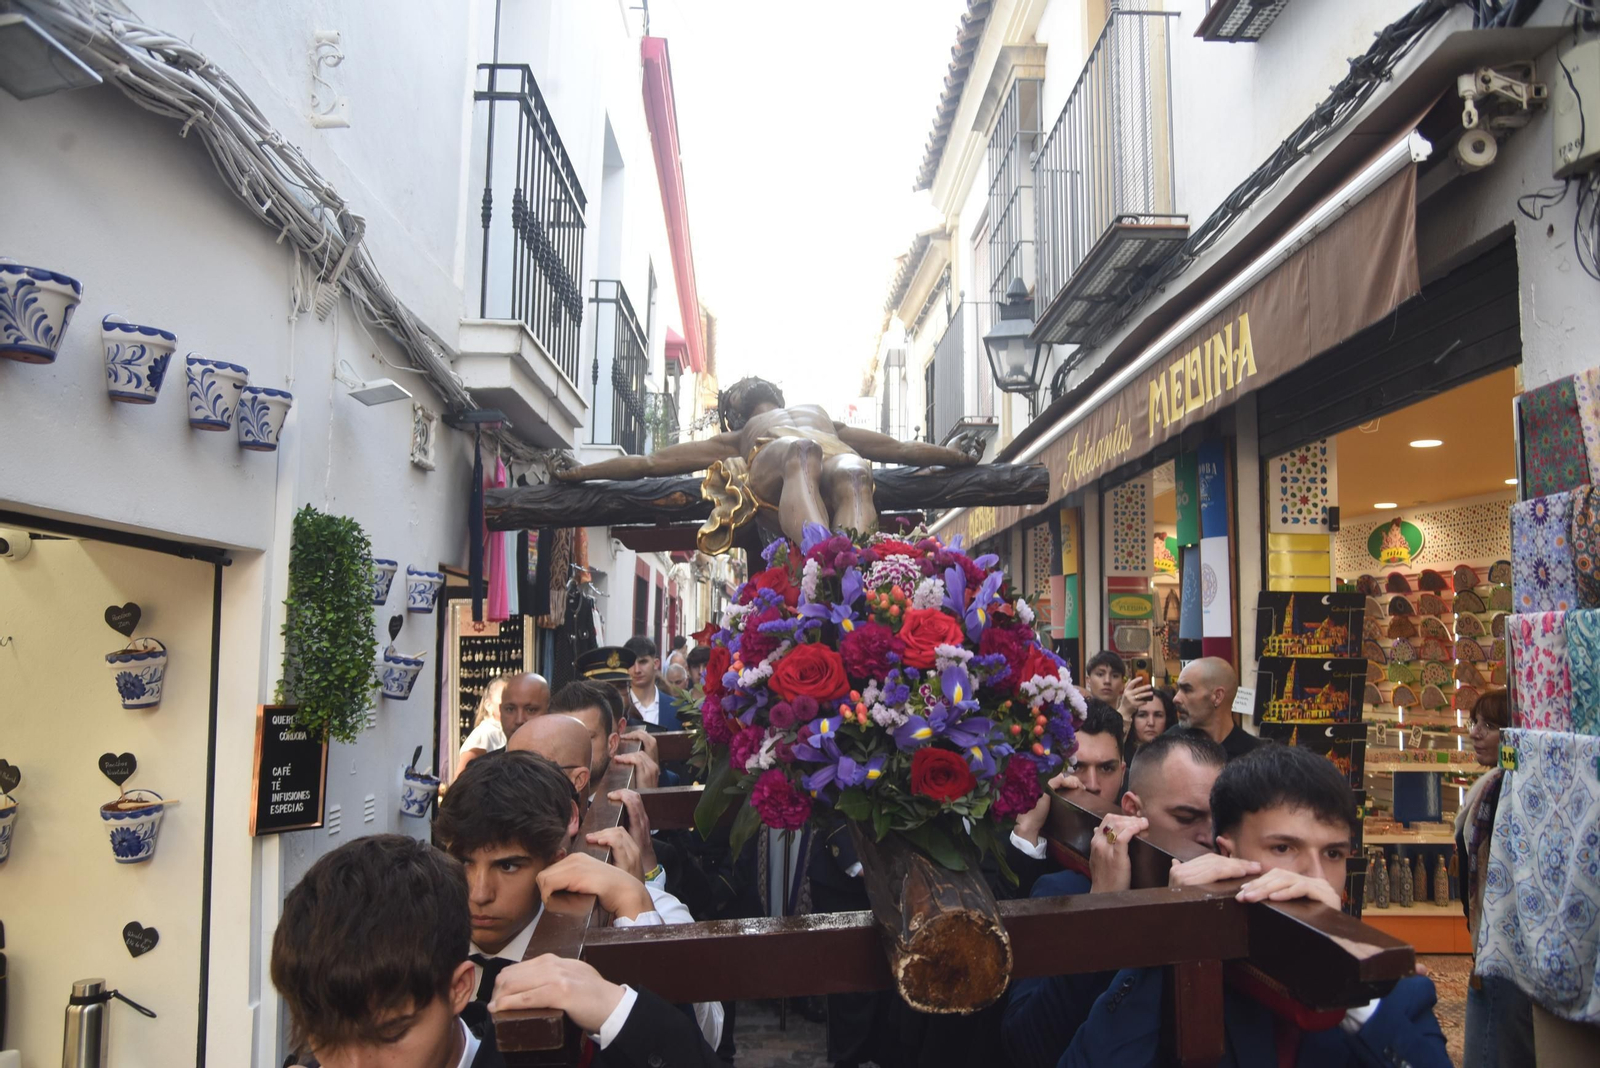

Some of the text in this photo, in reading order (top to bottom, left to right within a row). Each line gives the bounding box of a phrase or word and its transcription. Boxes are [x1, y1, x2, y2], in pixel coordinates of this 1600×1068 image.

[1149, 312, 1257, 438] MEDINA
[272, 763, 292, 776] CAFÉ
[271, 778, 282, 791] TÉ
[271, 790, 311, 803] INFUSIONES
[270, 802, 304, 815] ESPECIAS
